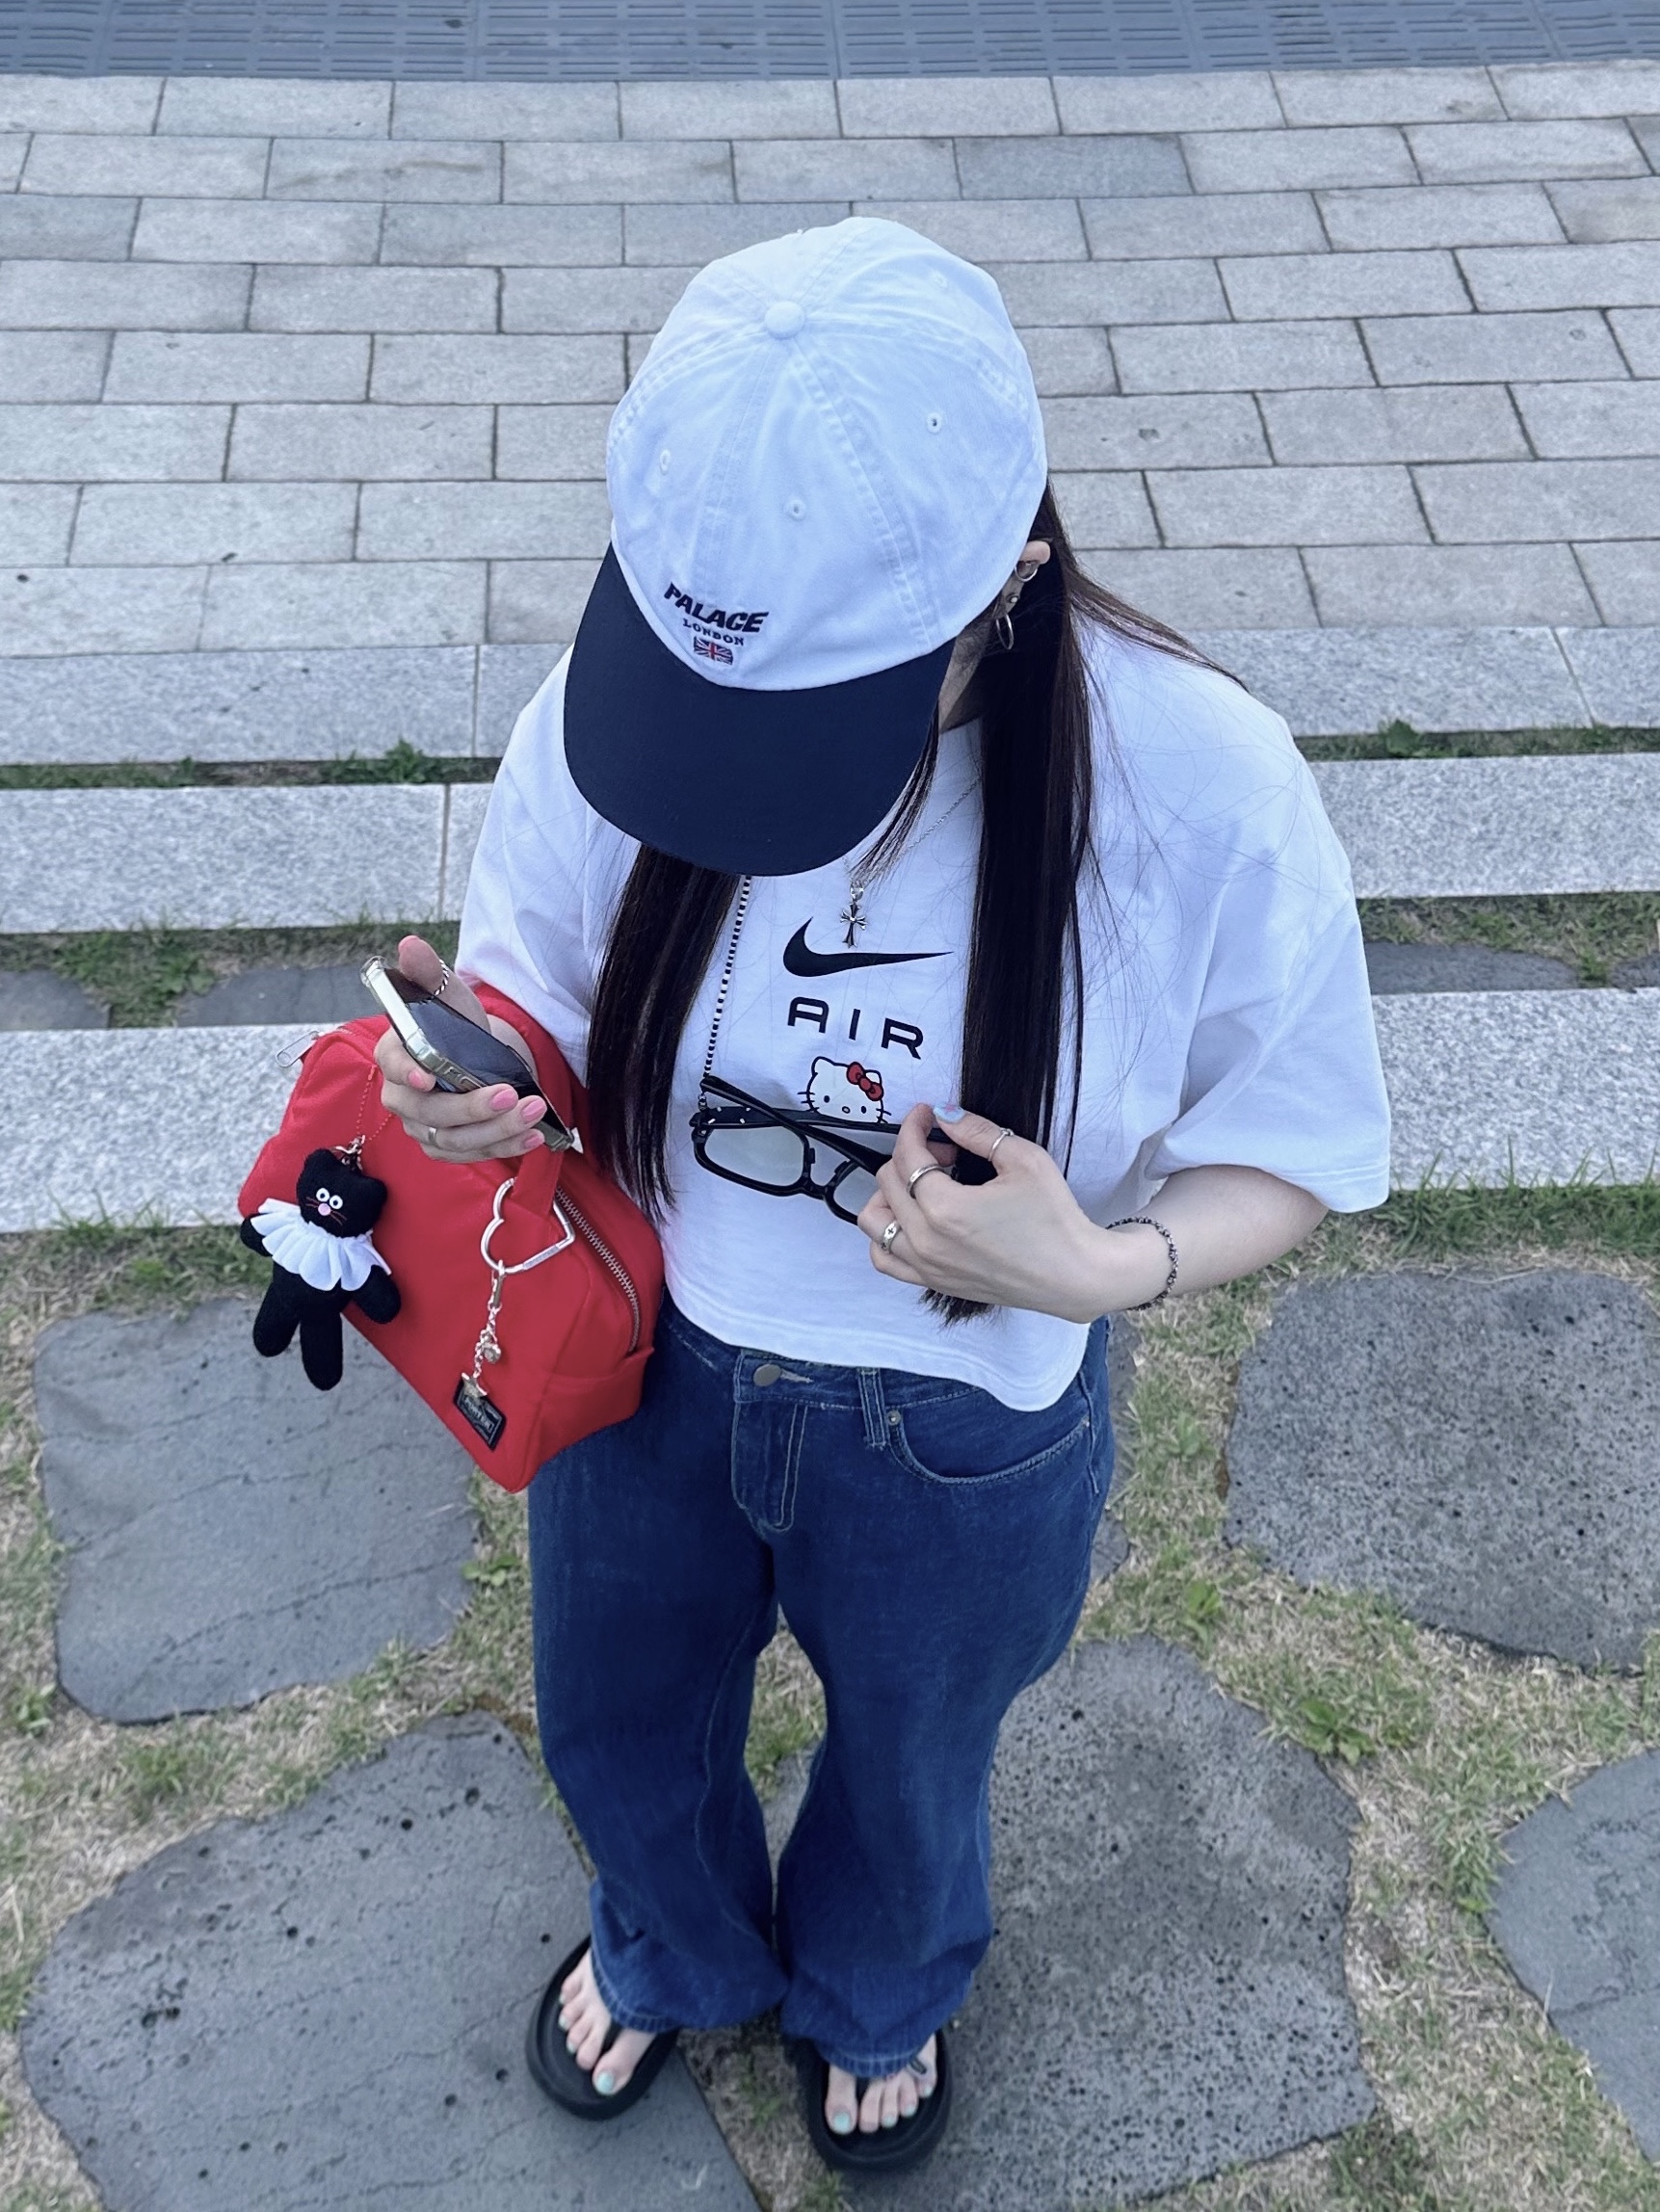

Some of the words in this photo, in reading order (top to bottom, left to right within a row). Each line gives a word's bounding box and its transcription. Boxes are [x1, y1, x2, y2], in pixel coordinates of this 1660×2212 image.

[664, 582, 769, 633] PALACE
[682, 619, 744, 646] LONDON
[787, 996, 924, 1060] AIR
